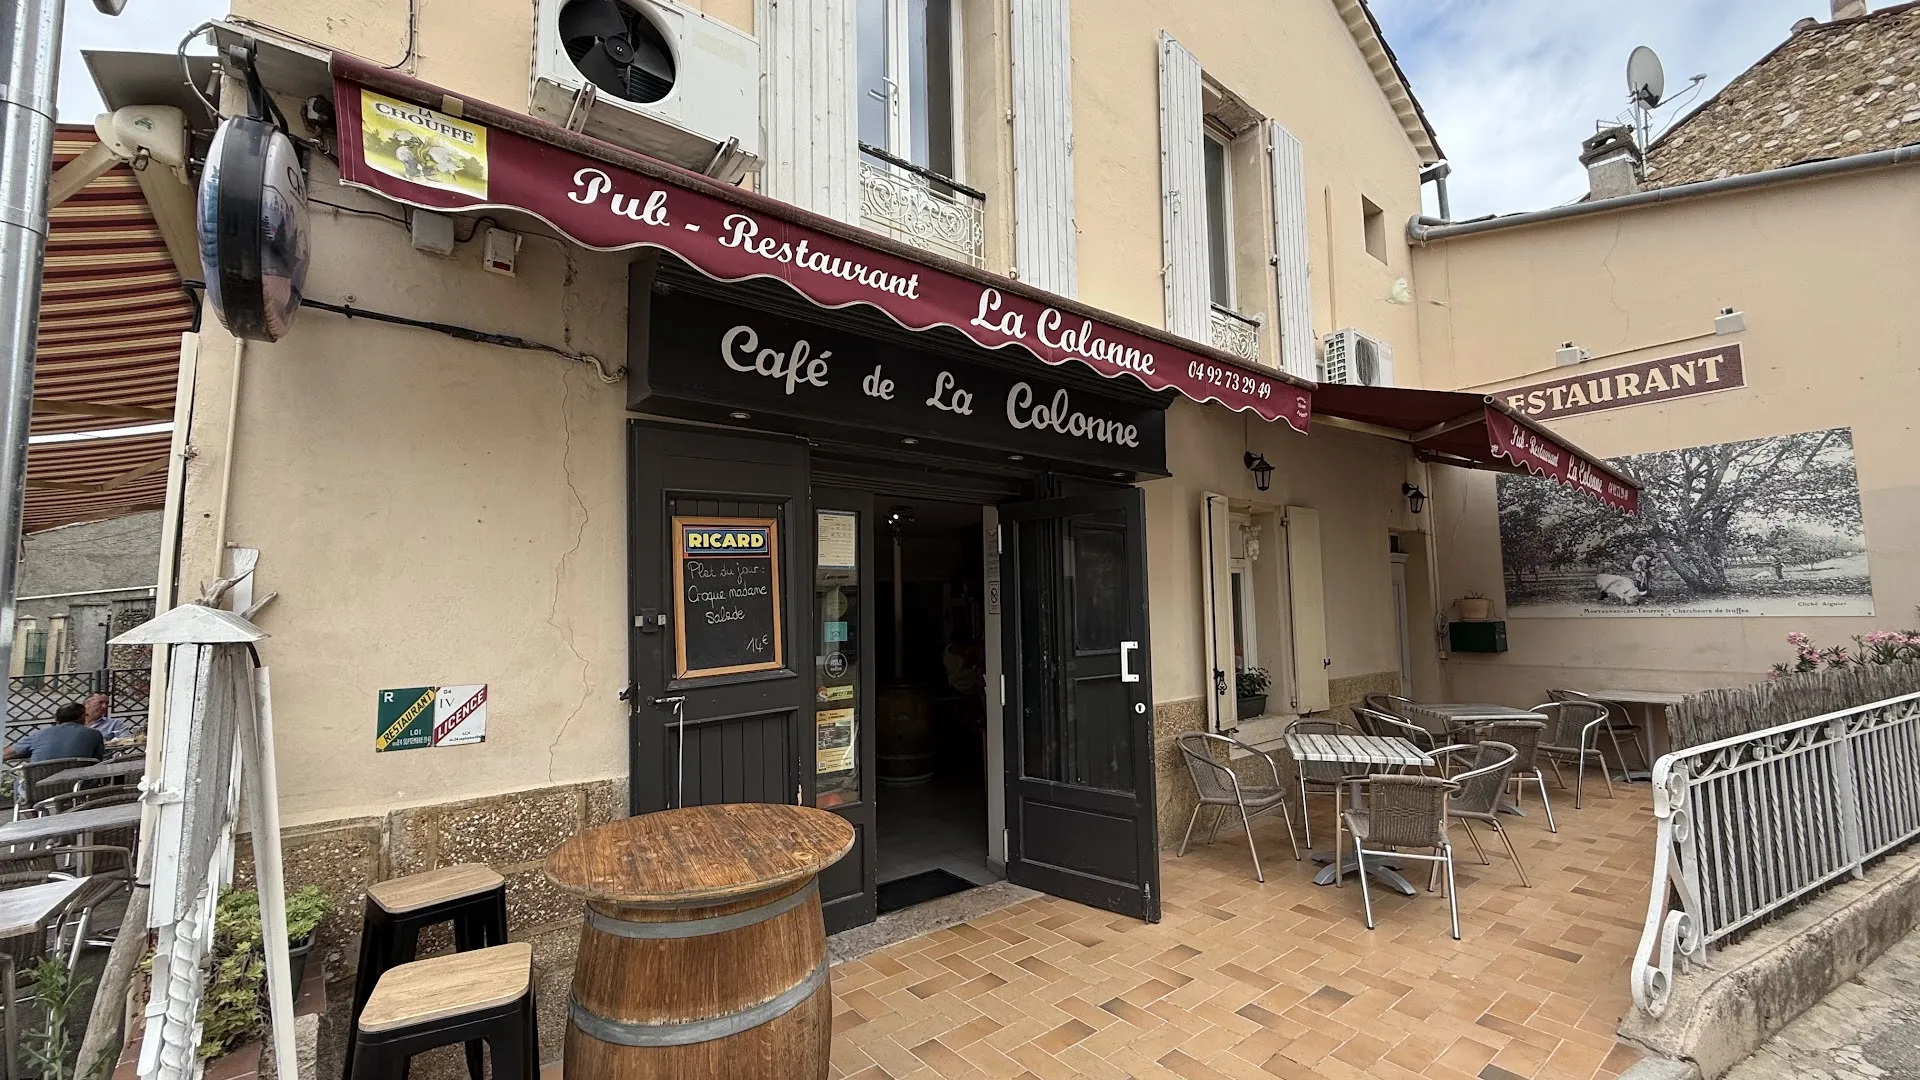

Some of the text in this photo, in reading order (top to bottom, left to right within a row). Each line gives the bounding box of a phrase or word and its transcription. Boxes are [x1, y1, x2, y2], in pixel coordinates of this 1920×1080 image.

[375, 103, 474, 144] CHOUFFE
[418, 108, 432, 118] LA
[567, 167, 671, 227] Pub
[718, 213, 920, 300] Restaurant
[970, 288, 1026, 340] La
[1037, 308, 1156, 376] Colonne
[1188, 360, 1204, 380] 04
[1207, 366, 1222, 386] 92
[1225, 371, 1240, 390] 73
[1242, 376, 1256, 394] 29
[1258, 382, 1271, 400] 49
[721, 325, 1140, 448] Café de La Colonne
[1507, 354, 1724, 415] ESTAURANT
[1566, 454, 1578, 482] La
[688, 533, 765, 549] RICARD
[720, 564, 734, 576] du
[688, 585, 726, 608] Croque
[746, 634, 768, 652] 14€
[384, 692, 394, 702] R
[440, 698, 455, 708] IV
[383, 692, 432, 744] RESTAURANT
[438, 690, 484, 739] LICENCE
